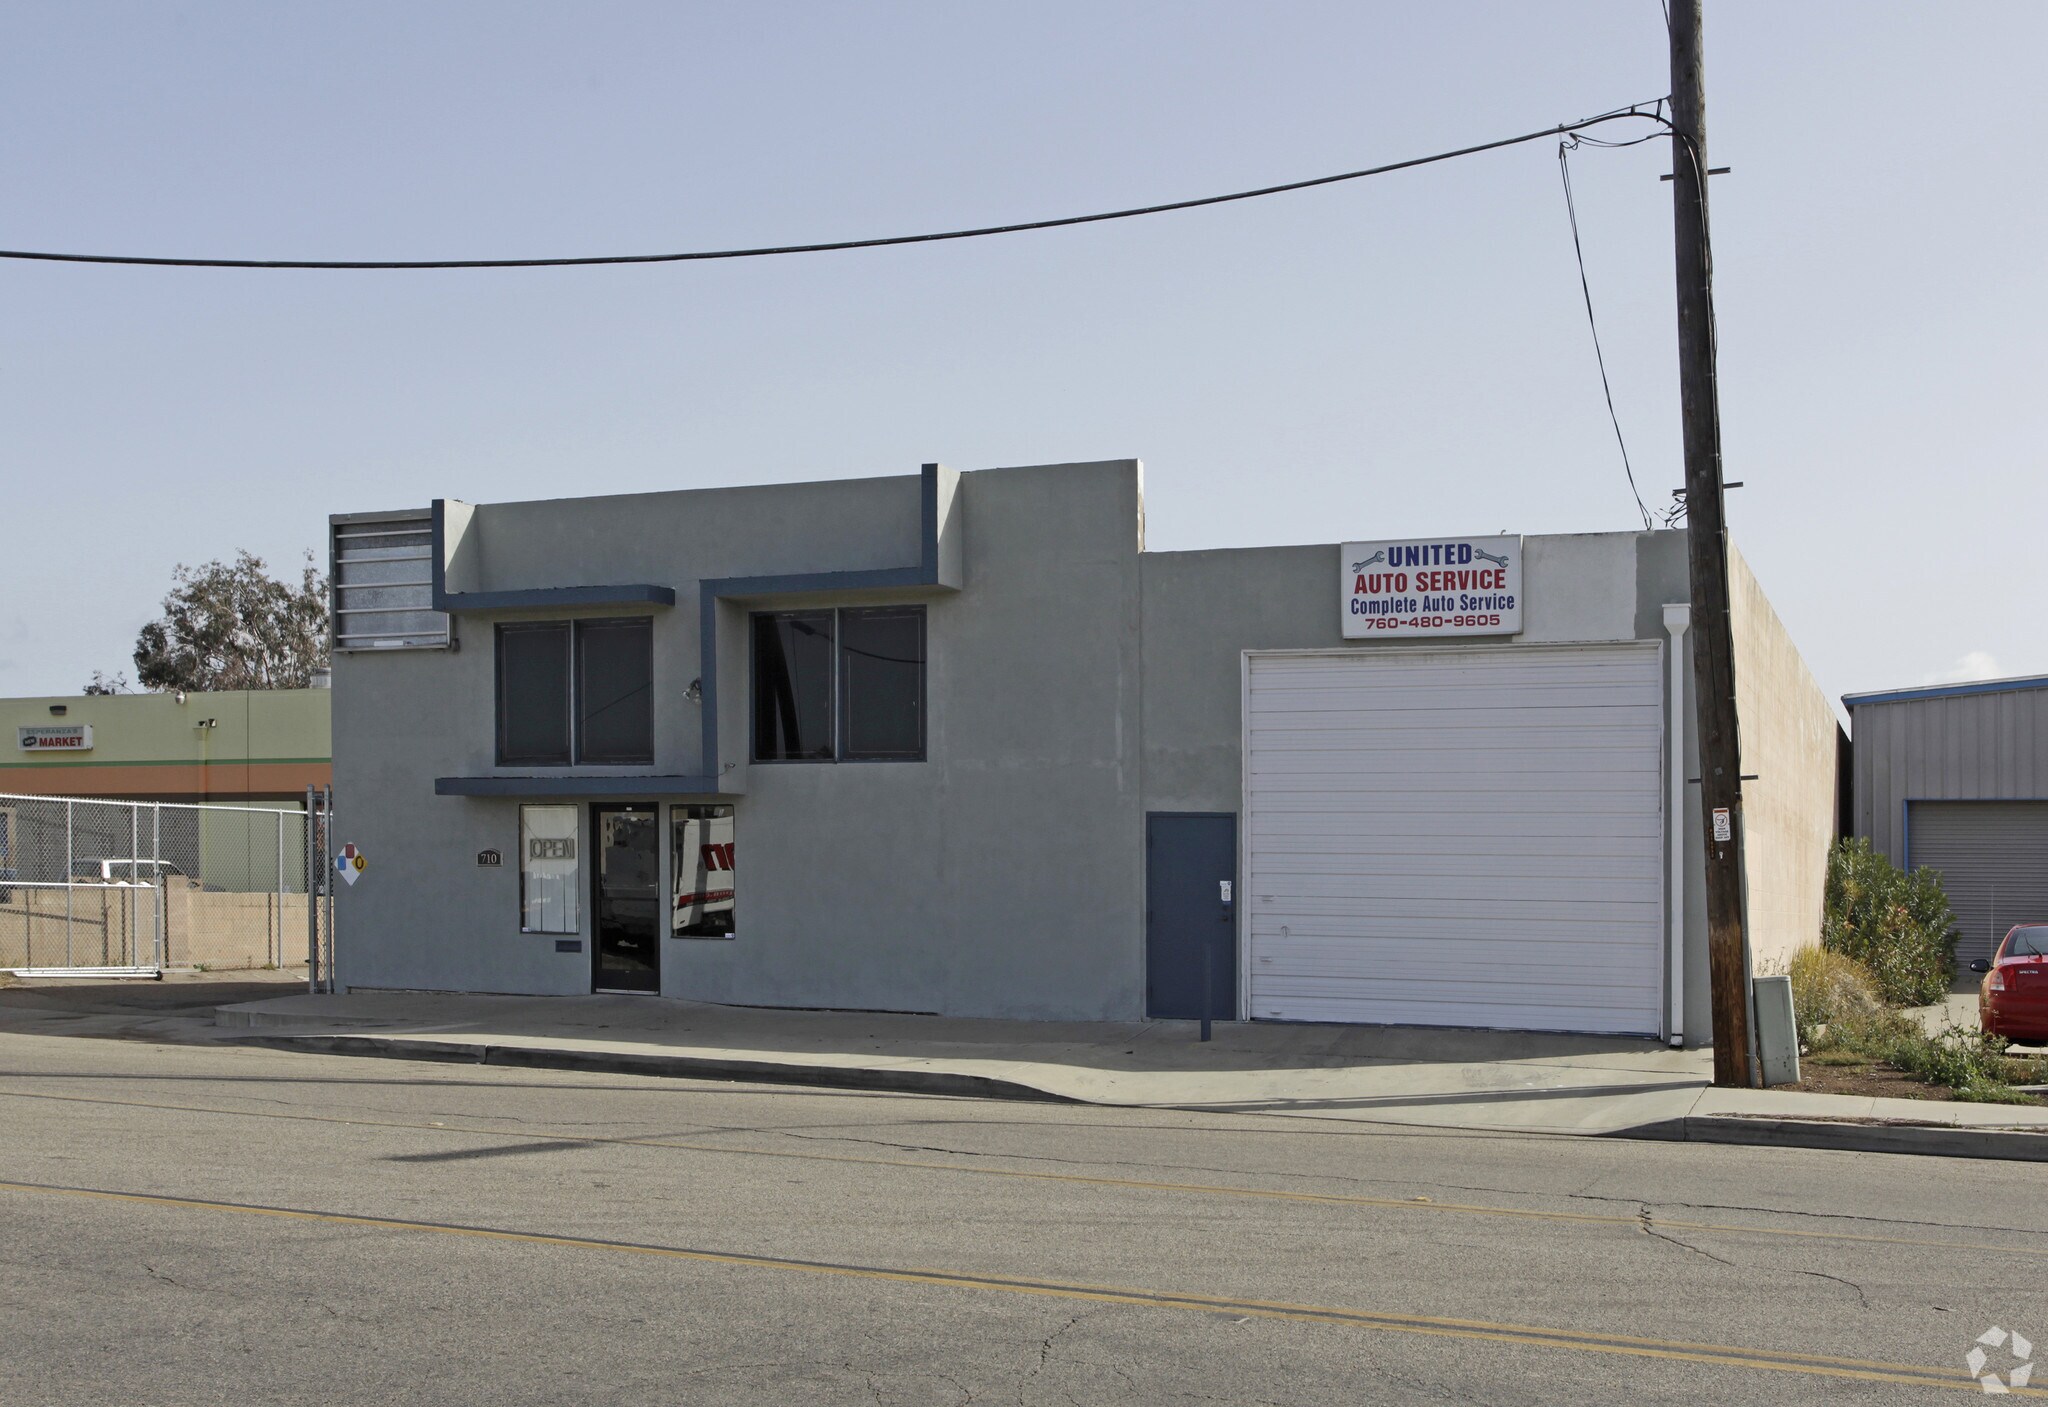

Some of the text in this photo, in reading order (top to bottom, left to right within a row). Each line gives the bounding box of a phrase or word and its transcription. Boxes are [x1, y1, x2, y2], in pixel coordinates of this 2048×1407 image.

[1388, 543, 1472, 567] UNITED
[1354, 569, 1506, 594] AUTO SERVICE
[1351, 593, 1515, 616] Complete Auto Service
[1365, 614, 1500, 630] 760-480-9605
[39, 736, 82, 747] MARKET
[532, 839, 571, 858] OPEN
[481, 853, 497, 864] 710
